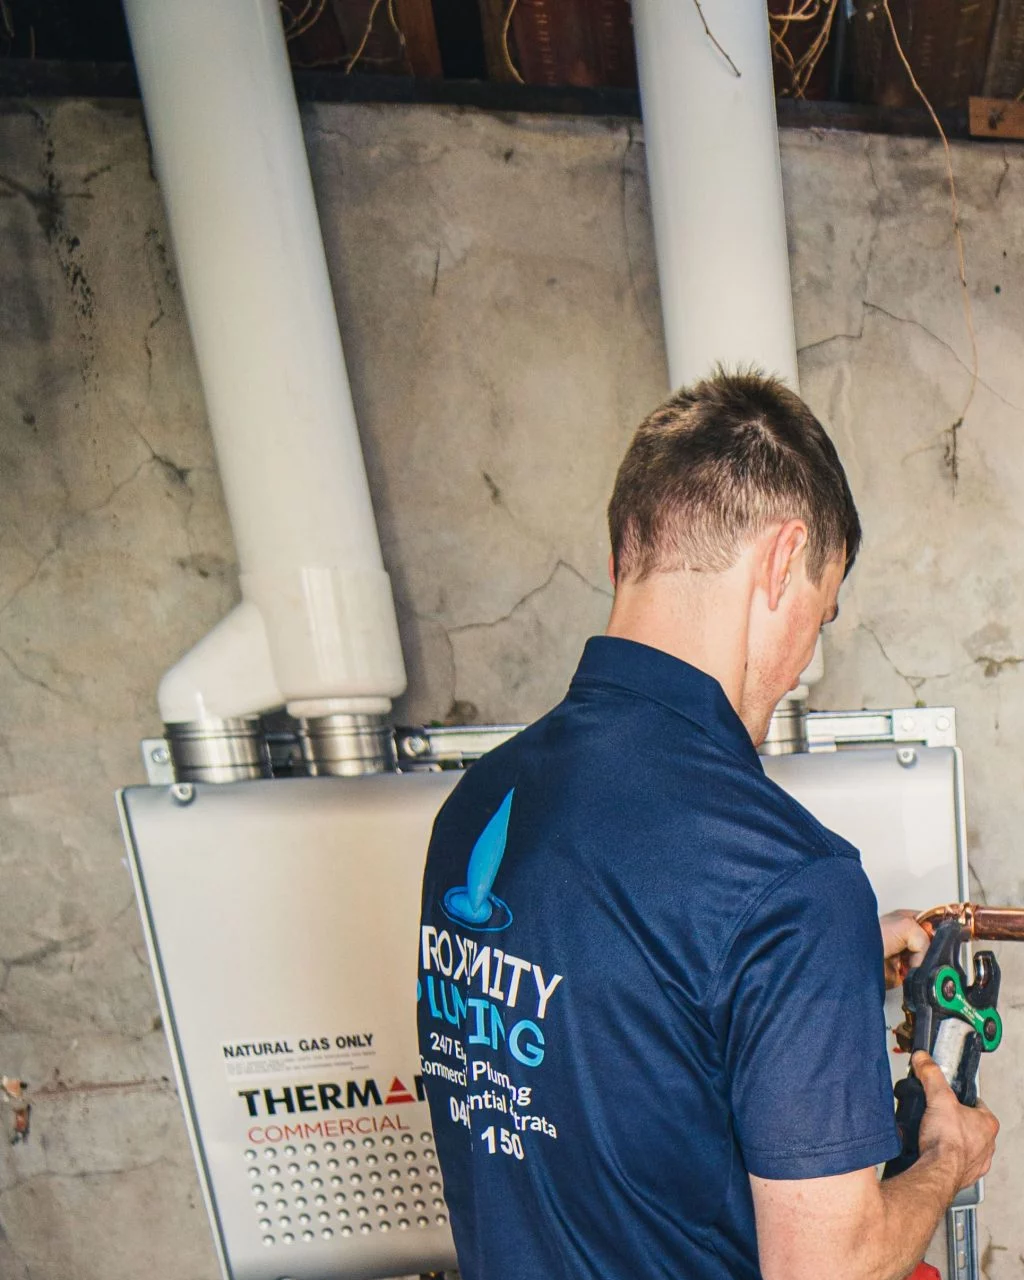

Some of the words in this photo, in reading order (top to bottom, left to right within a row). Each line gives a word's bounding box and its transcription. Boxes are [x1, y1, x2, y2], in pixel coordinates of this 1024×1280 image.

[421, 925, 563, 1019] ROXIMITY
[223, 1041, 293, 1058] NATURAL
[298, 1037, 330, 1051] GAS
[336, 1033, 373, 1049] ONLY
[472, 1061, 532, 1106] Plumng
[248, 1114, 410, 1144] COMMERCIAL
[512, 1111, 557, 1139] trata
